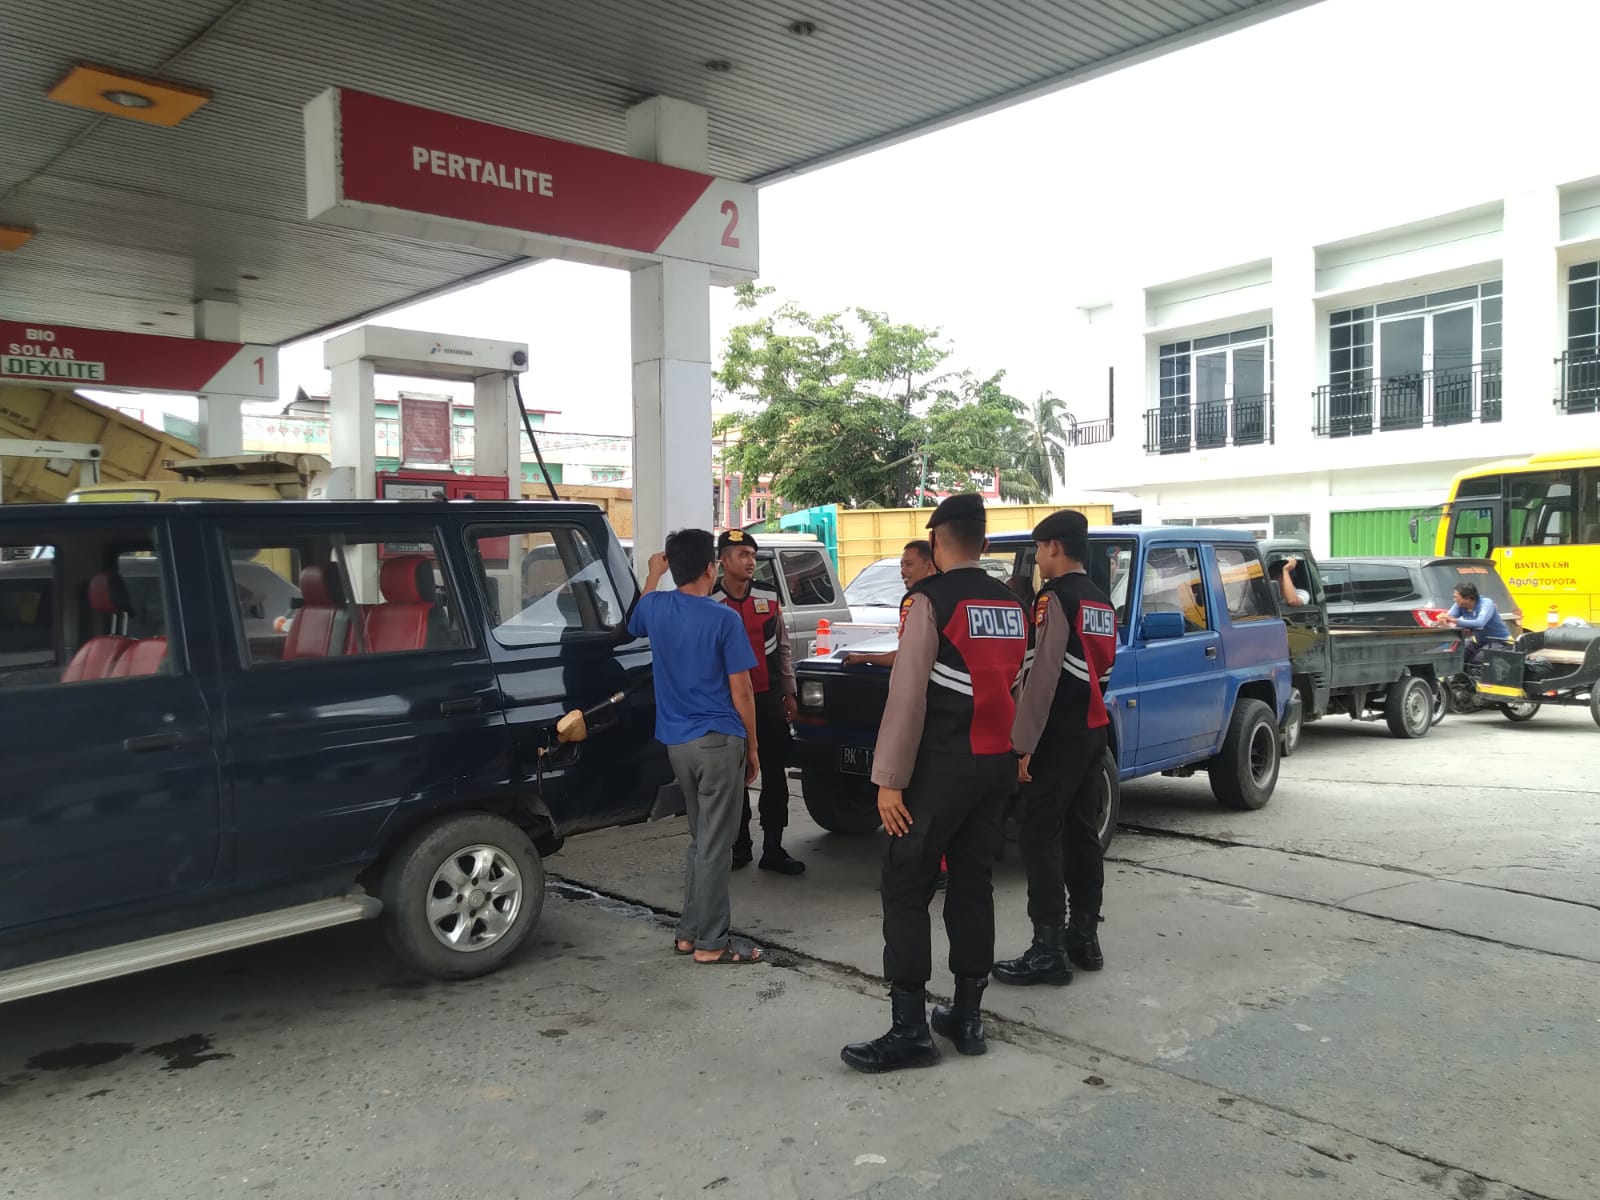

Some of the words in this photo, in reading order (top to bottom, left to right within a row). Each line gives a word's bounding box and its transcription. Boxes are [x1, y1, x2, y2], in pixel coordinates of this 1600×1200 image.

[412, 146, 554, 198] PERTALITE
[720, 199, 740, 248] 2
[26, 328, 56, 341] BIO
[9, 343, 75, 359] SOLAR
[8, 358, 100, 378] DEXLITE
[253, 356, 265, 385] 1
[970, 608, 1023, 636] POLISI
[1082, 608, 1113, 634] POLISI
[844, 747, 857, 764] BK
